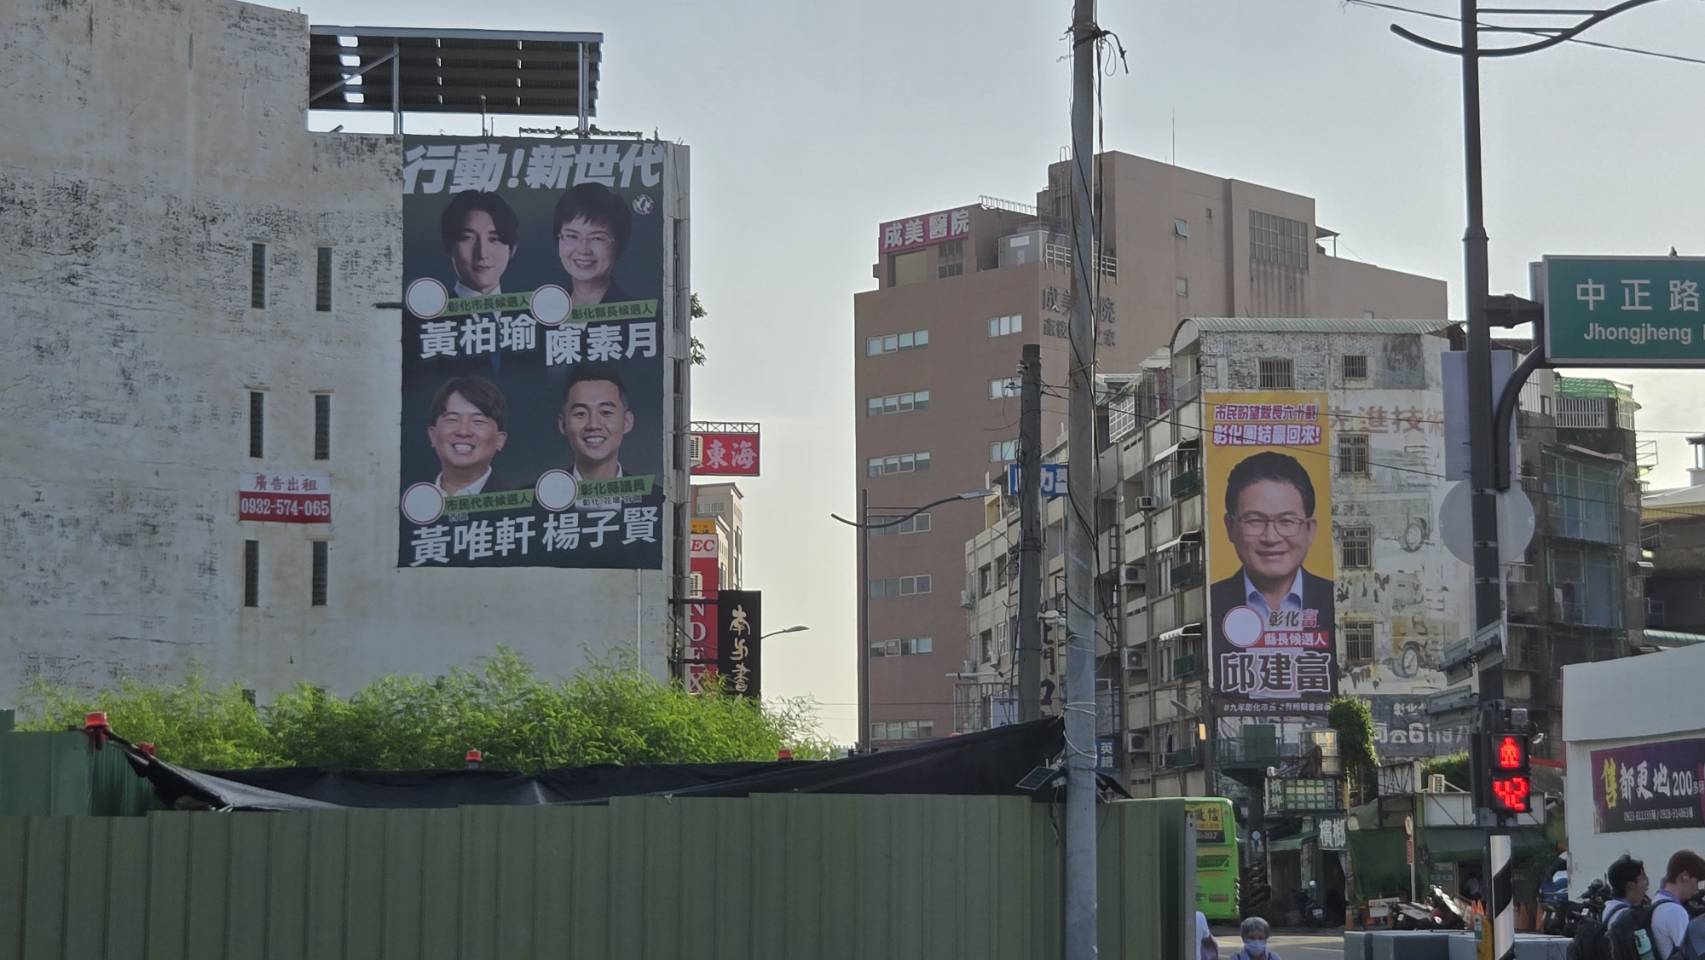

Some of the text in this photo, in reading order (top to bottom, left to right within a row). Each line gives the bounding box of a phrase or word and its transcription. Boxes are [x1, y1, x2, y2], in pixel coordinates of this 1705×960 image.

[884, 208, 969, 249] 成美醫院
[1042, 286, 1115, 323] 成美院
[1576, 278, 1699, 312] 中正路
[572, 303, 653, 319] 彰化縣長候選人
[420, 314, 537, 359] 黃柏瑜
[545, 322, 658, 366] 陳素月
[1583, 322, 1692, 345] Jhongjheng
[706, 439, 757, 469] 東海
[255, 472, 318, 491] 廣告出租
[581, 479, 646, 495] 彰化縣議員
[241, 498, 329, 516] 0932-574-065
[446, 492, 530, 511] 市民代表候選人
[409, 516, 536, 567] 黃唯軒
[542, 506, 659, 552] 楊子賢
[1268, 608, 1318, 628] 彰化富
[1264, 632, 1327, 647] 縣長候選人
[1220, 651, 1332, 693] 邱建富
[1319, 818, 1346, 848] 檳榔
